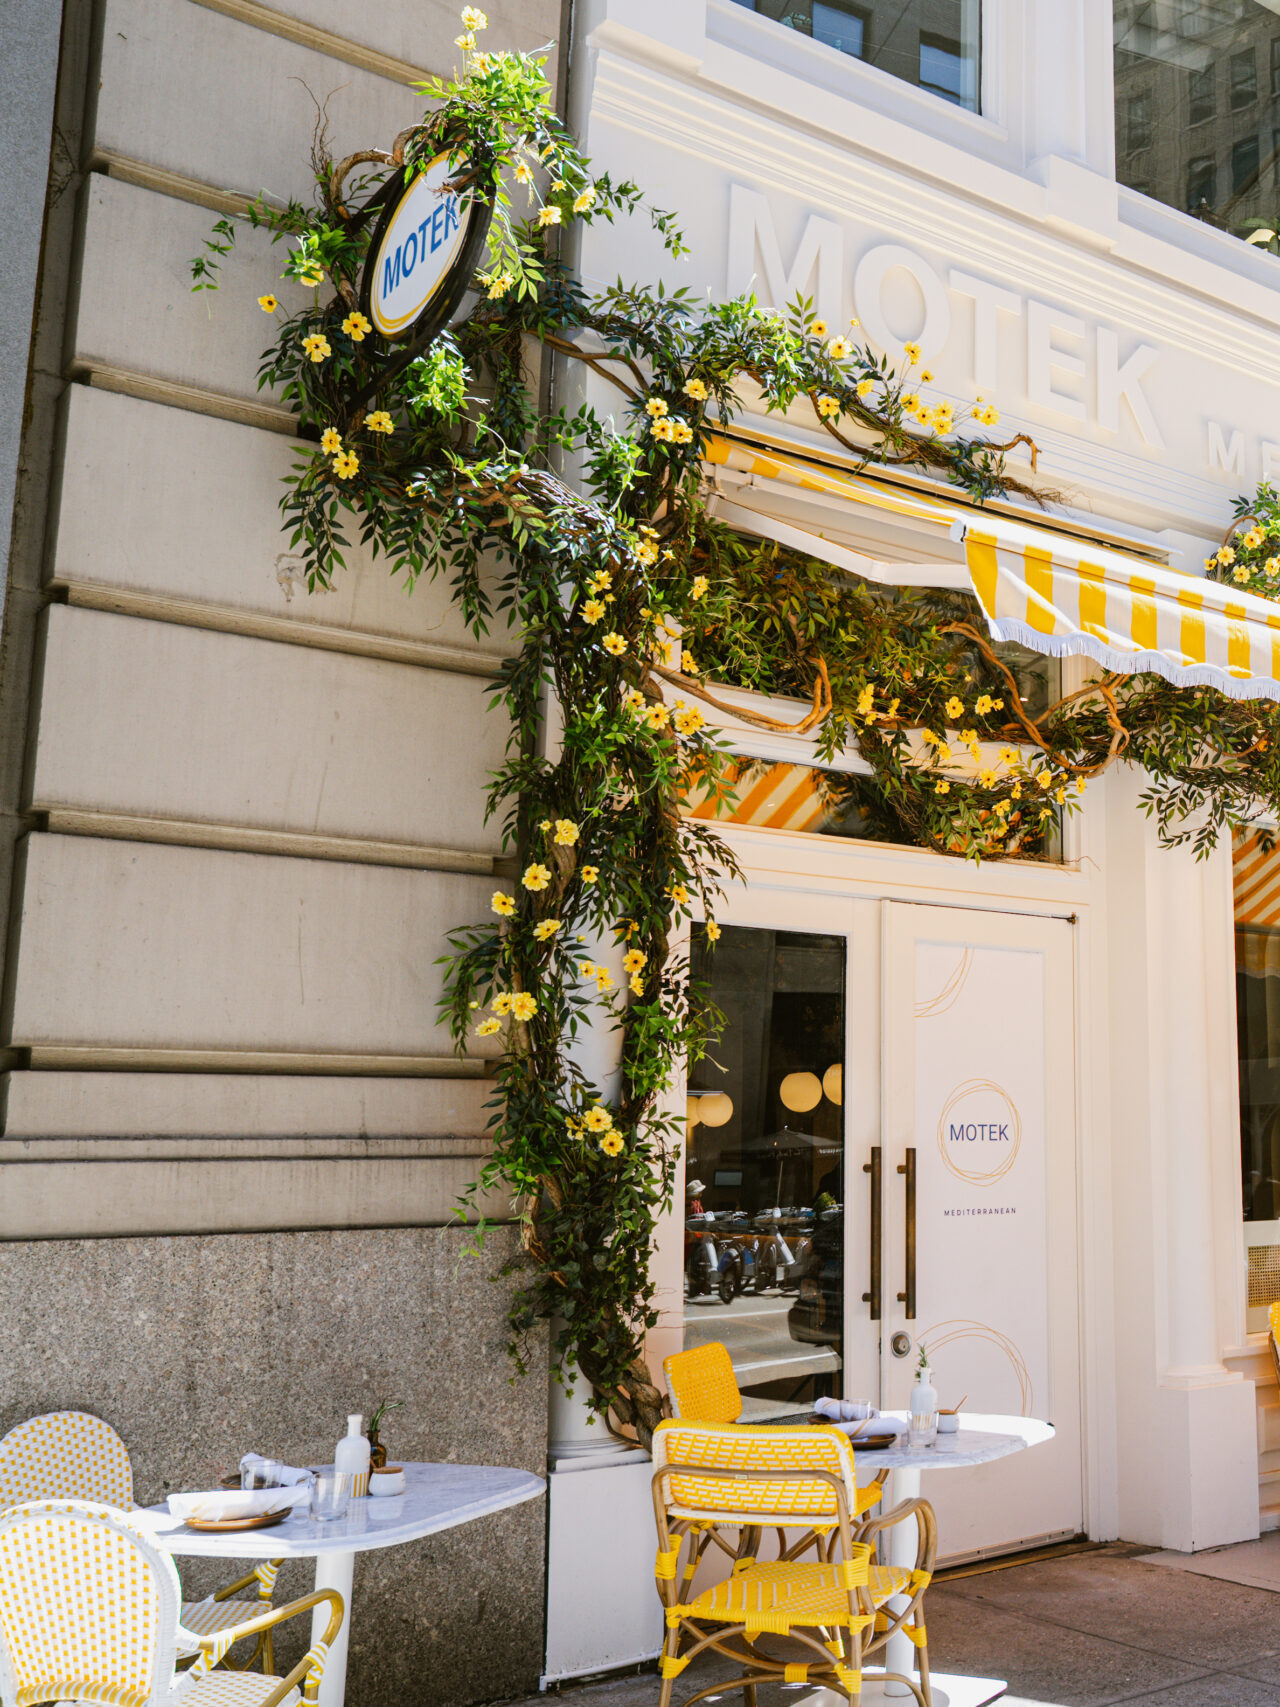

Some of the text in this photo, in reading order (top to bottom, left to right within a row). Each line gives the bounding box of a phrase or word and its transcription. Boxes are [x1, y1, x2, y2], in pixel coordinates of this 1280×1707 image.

[382, 195, 460, 300] MOTEK
[726, 183, 1167, 450] MOTEK
[950, 1123, 1009, 1141] MOTEK
[944, 1208, 1016, 1216] MEDITERRANEAN
